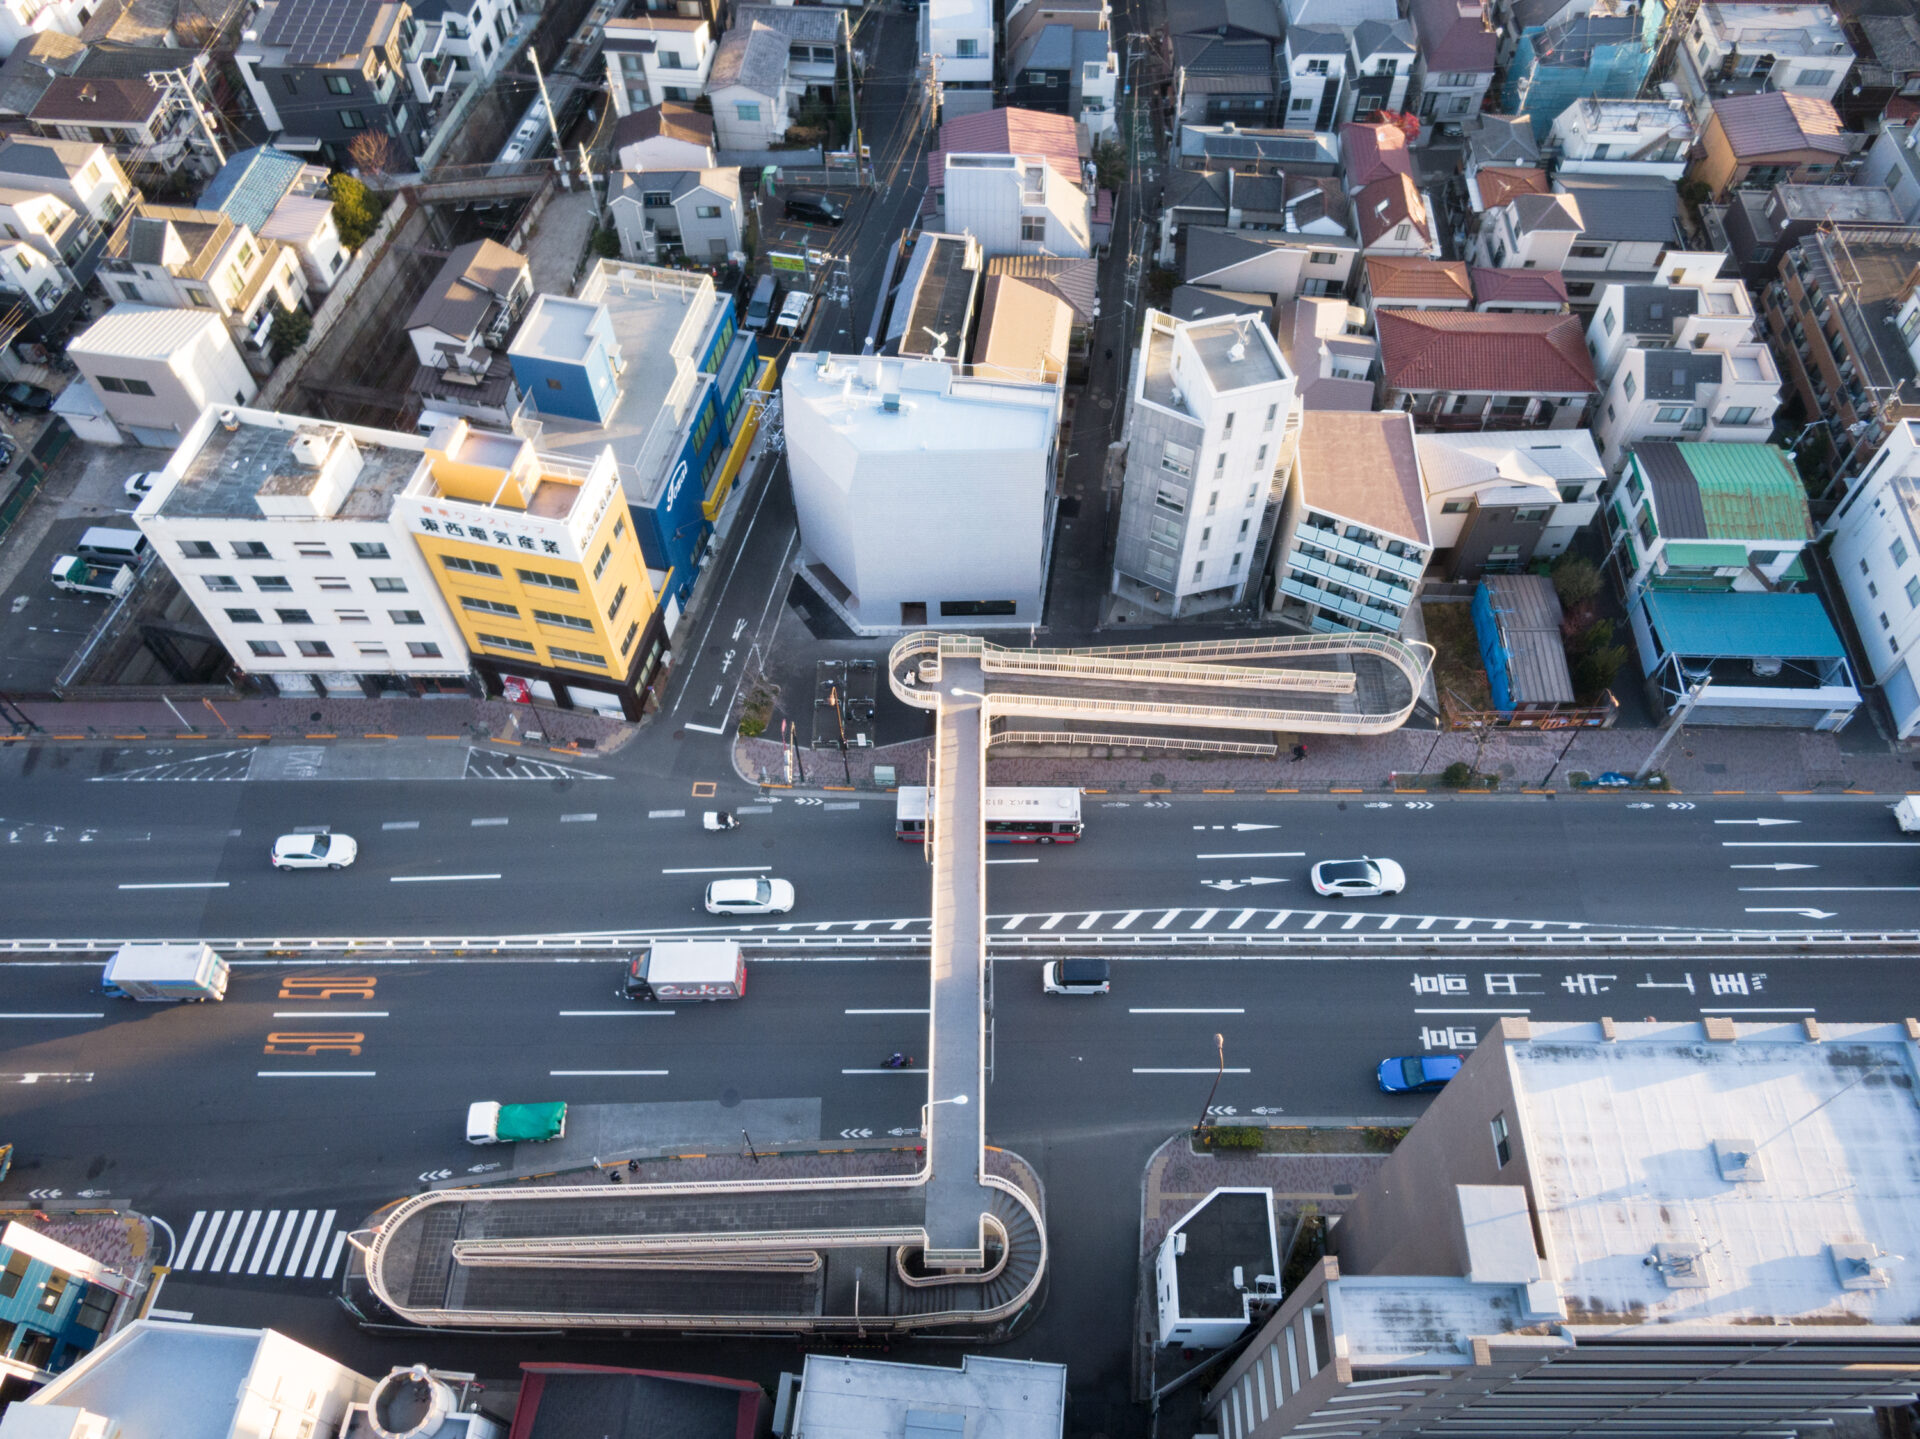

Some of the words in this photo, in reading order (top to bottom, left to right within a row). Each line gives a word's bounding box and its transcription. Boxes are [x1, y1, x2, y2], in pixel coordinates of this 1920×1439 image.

[419, 517, 561, 555] 東西電気産業
[278, 976, 377, 999] 50
[264, 1032, 365, 1056] 50
